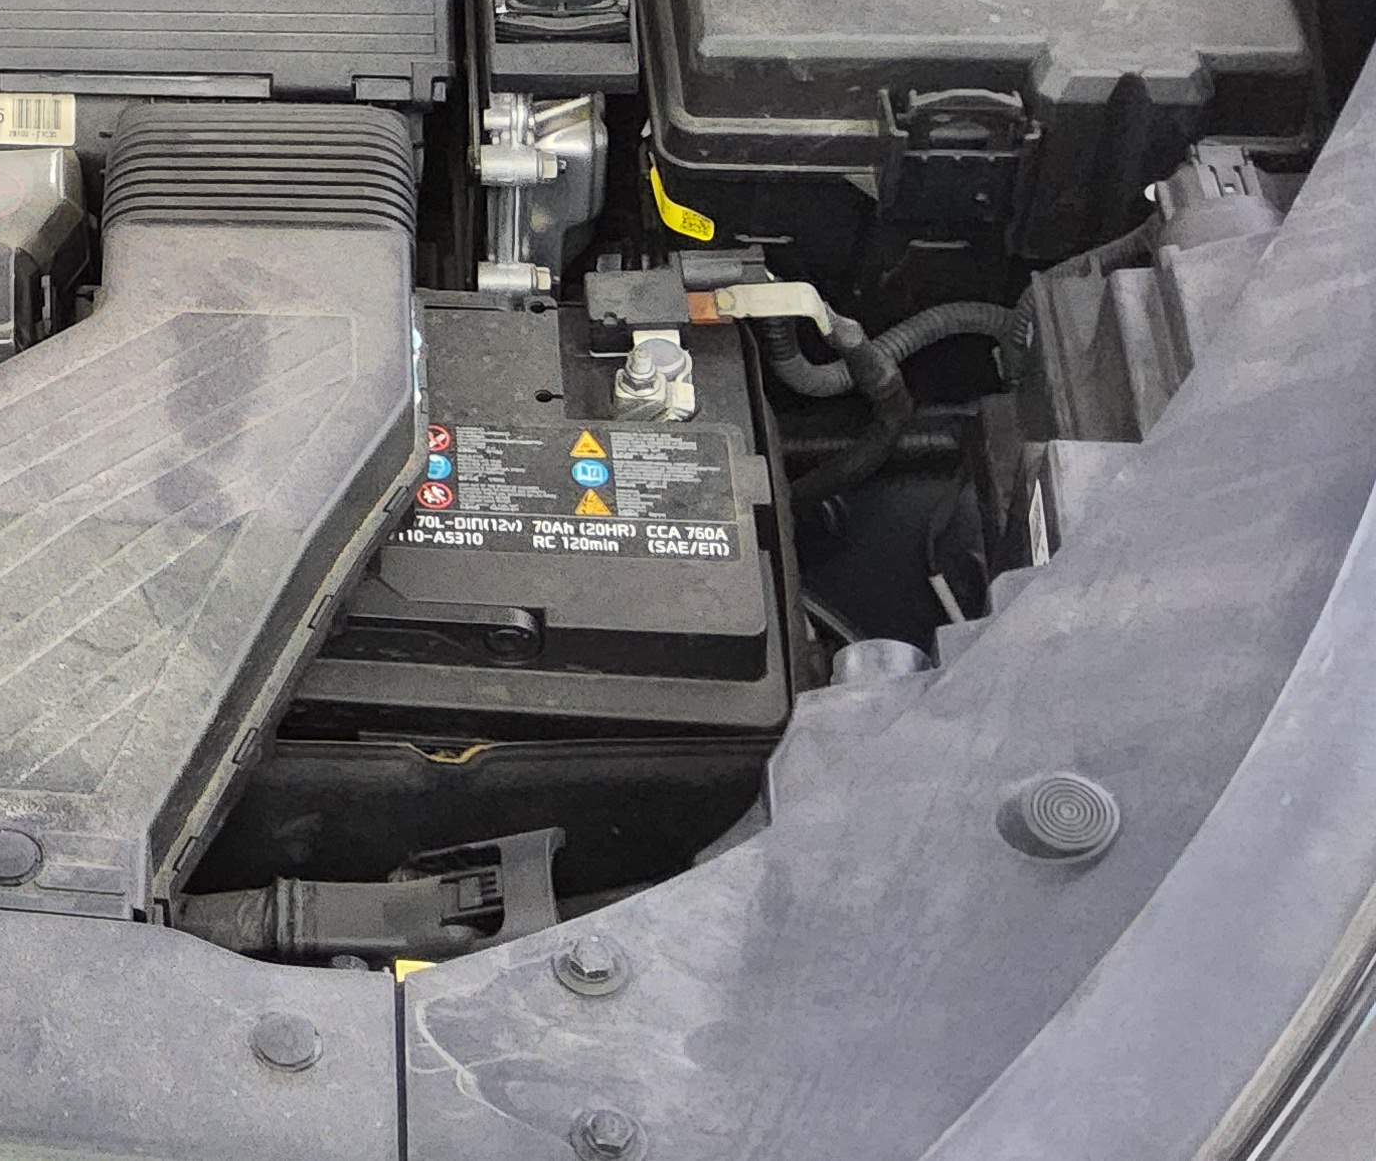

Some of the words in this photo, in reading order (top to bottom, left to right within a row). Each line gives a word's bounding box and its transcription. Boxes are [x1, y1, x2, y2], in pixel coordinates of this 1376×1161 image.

[532, 520, 575, 536] 70Ah
[579, 523, 637, 539] (20HR)
[646, 525, 681, 540] CCA
[685, 527, 728, 541] 760A
[532, 535, 556, 549] RC
[561, 536, 619, 553] 120min
